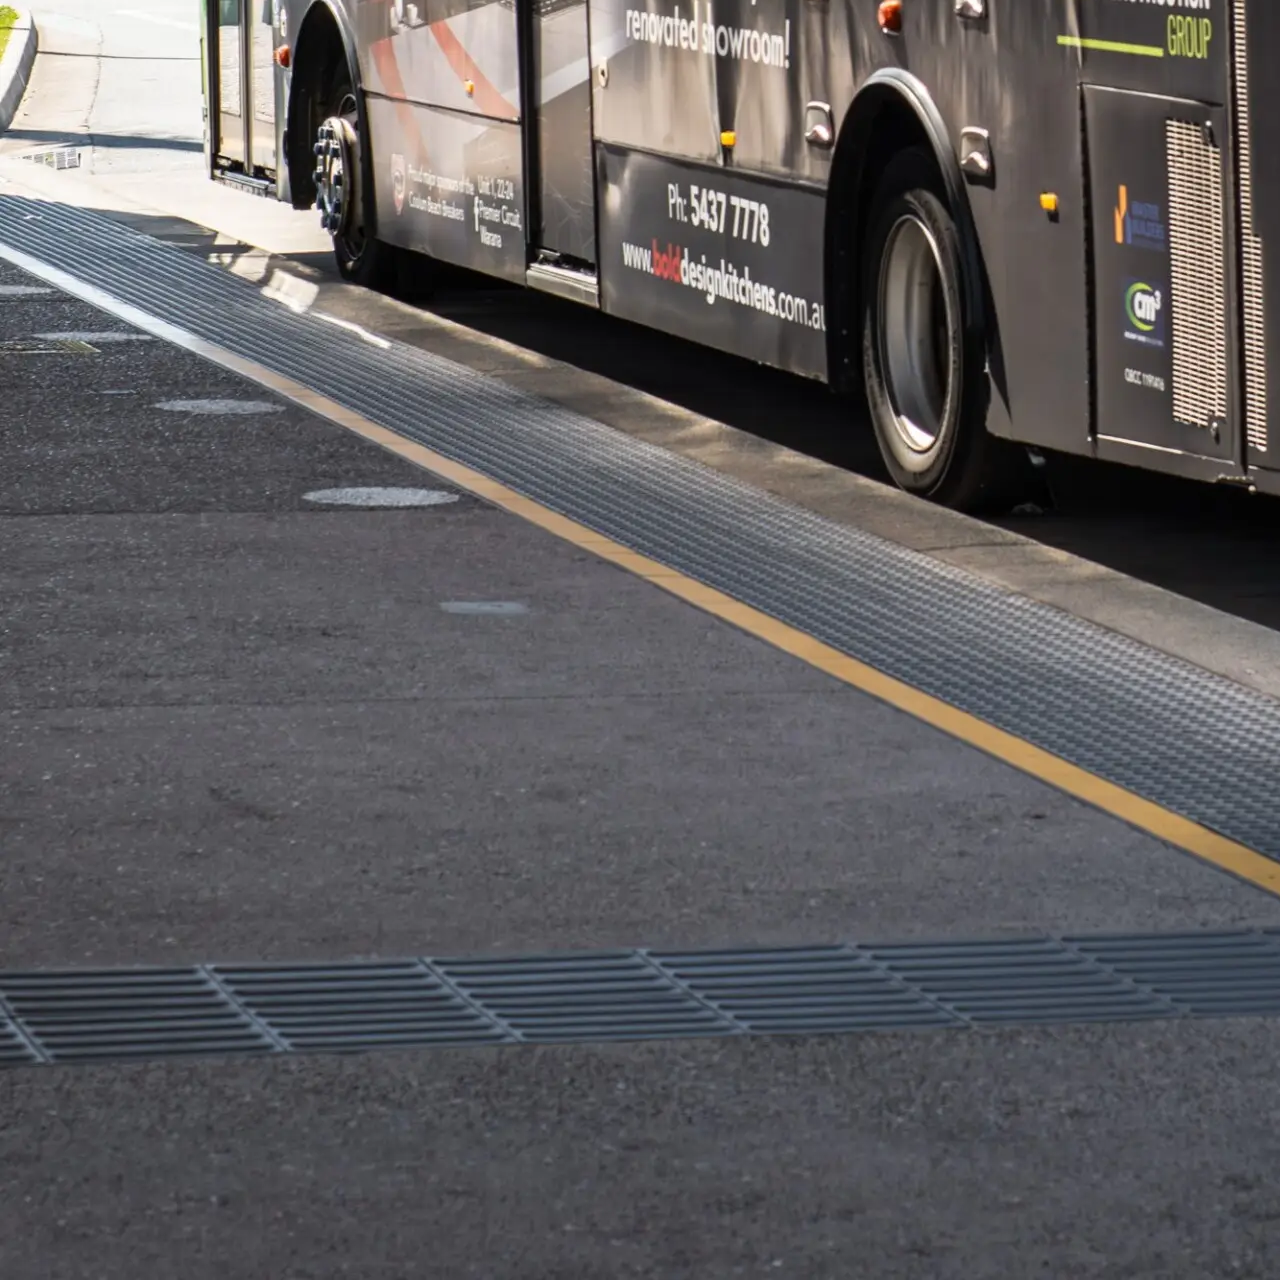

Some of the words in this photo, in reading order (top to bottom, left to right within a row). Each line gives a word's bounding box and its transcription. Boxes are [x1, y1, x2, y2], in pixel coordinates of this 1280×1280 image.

[626, 0, 698, 51] renovated
[702, 11, 791, 68] showroom!
[1167, 14, 1212, 59] GROUP
[667, 183, 688, 222] Ph:
[689, 184, 727, 234] 5437
[729, 195, 771, 247] 7778
